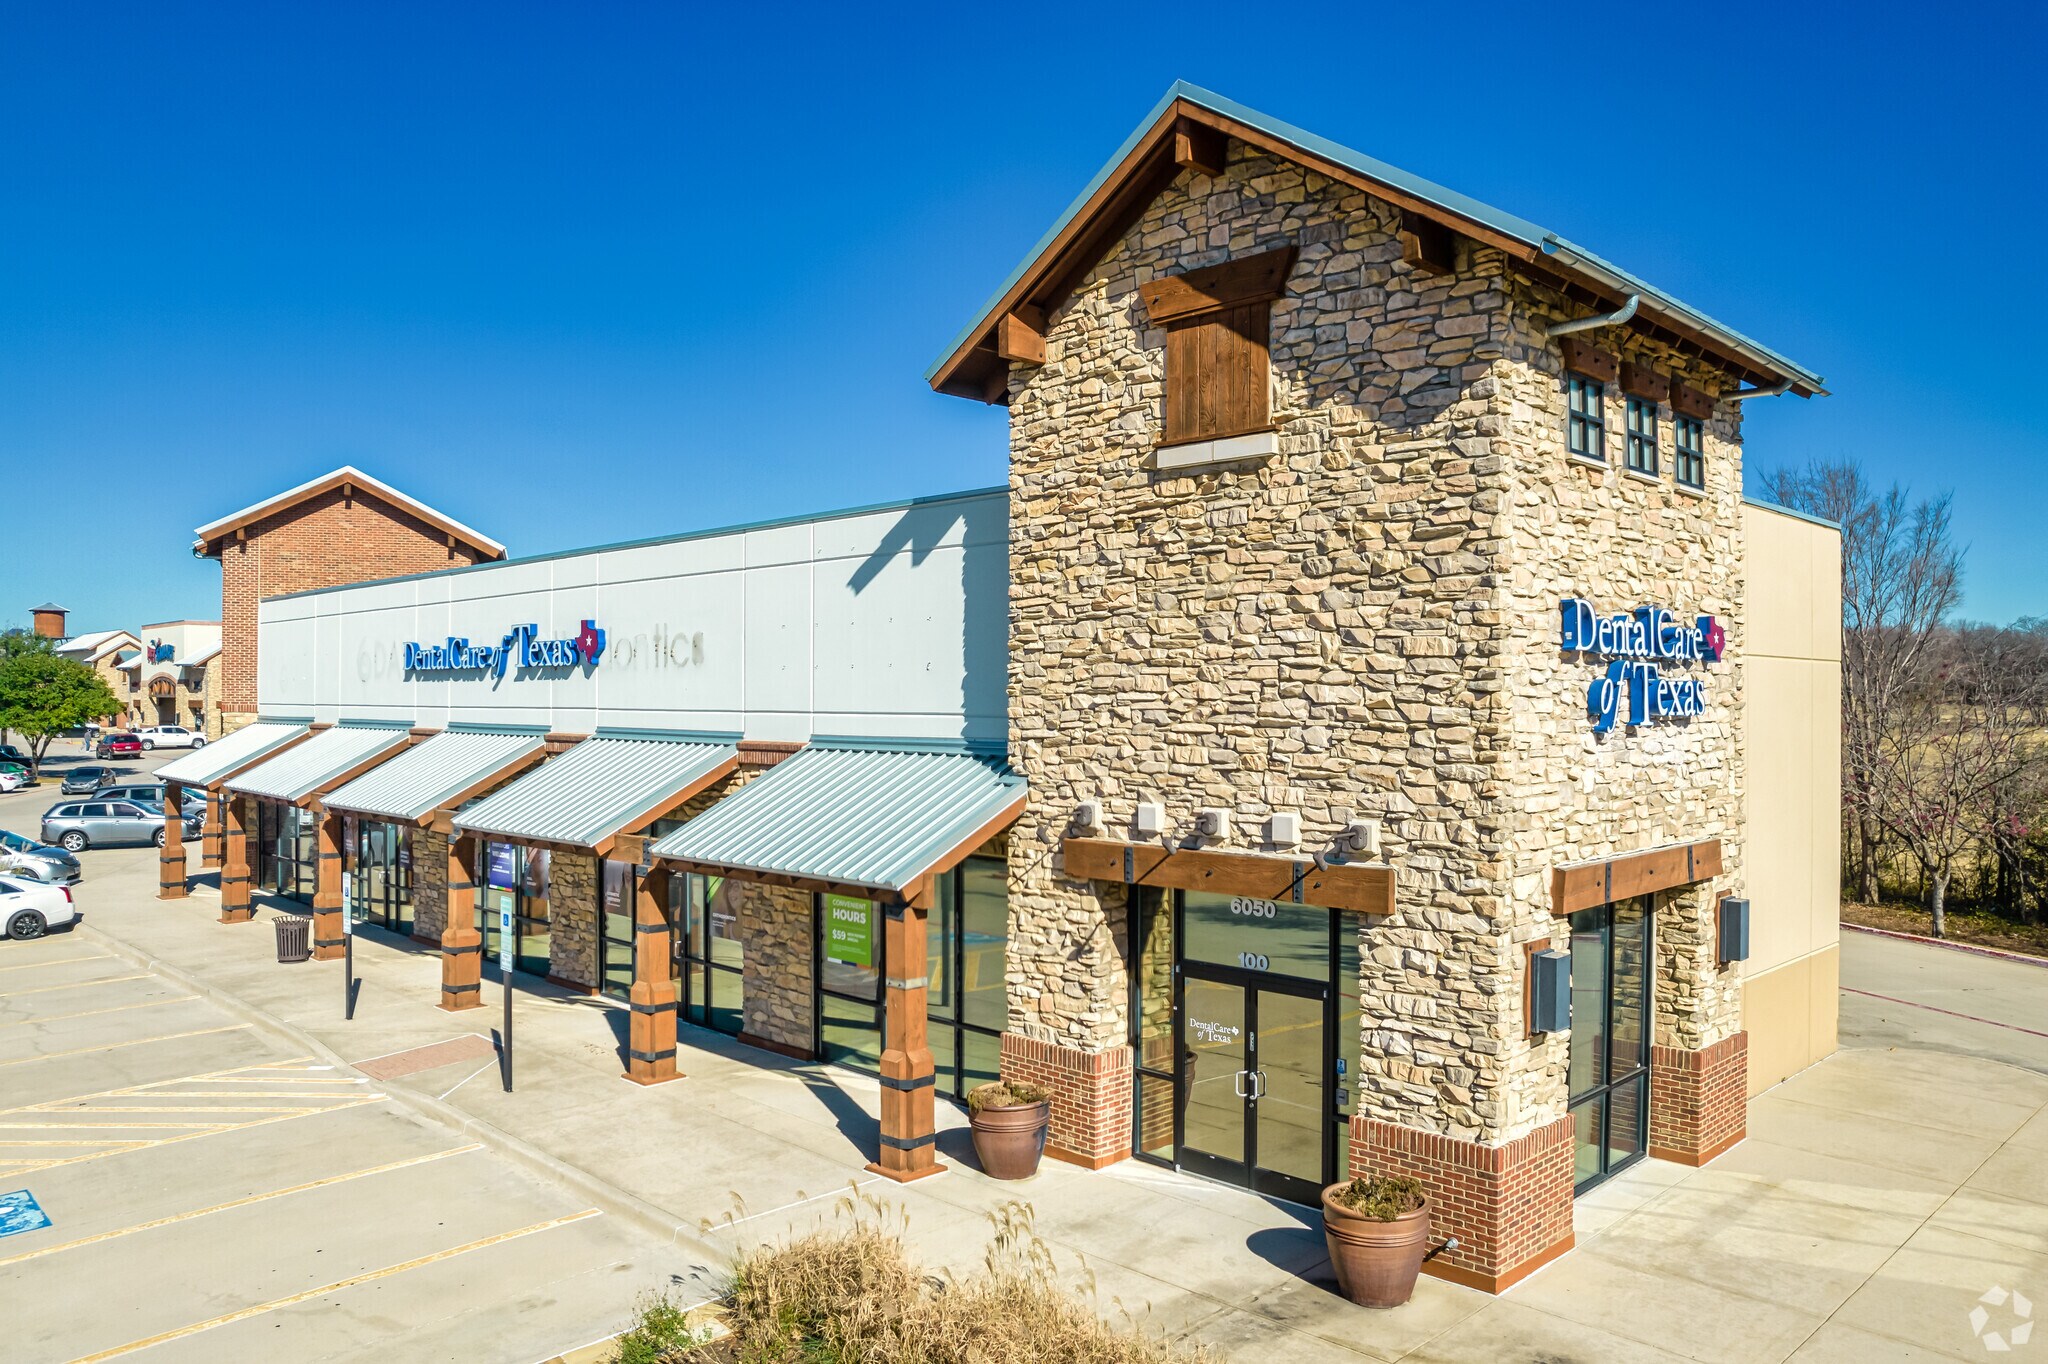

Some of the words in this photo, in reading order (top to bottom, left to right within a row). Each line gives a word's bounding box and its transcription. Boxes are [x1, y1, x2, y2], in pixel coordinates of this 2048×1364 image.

[1569, 598, 1704, 660] DentalCare
[403, 637, 486, 671] DentalCare
[487, 635, 512, 678] of
[511, 623, 574, 669] Texas
[1597, 660, 1631, 733] of
[1631, 662, 1706, 726] Texas
[832, 898, 867, 911] CONVENIENT
[1230, 897, 1277, 919] 6050
[832, 907, 867, 925] HOURS
[832, 928, 847, 941] $59
[1238, 952, 1270, 971] 100
[1189, 1017, 1232, 1035] DentalCare
[1197, 1029, 1206, 1041] of
[1205, 1029, 1232, 1044] Texas
